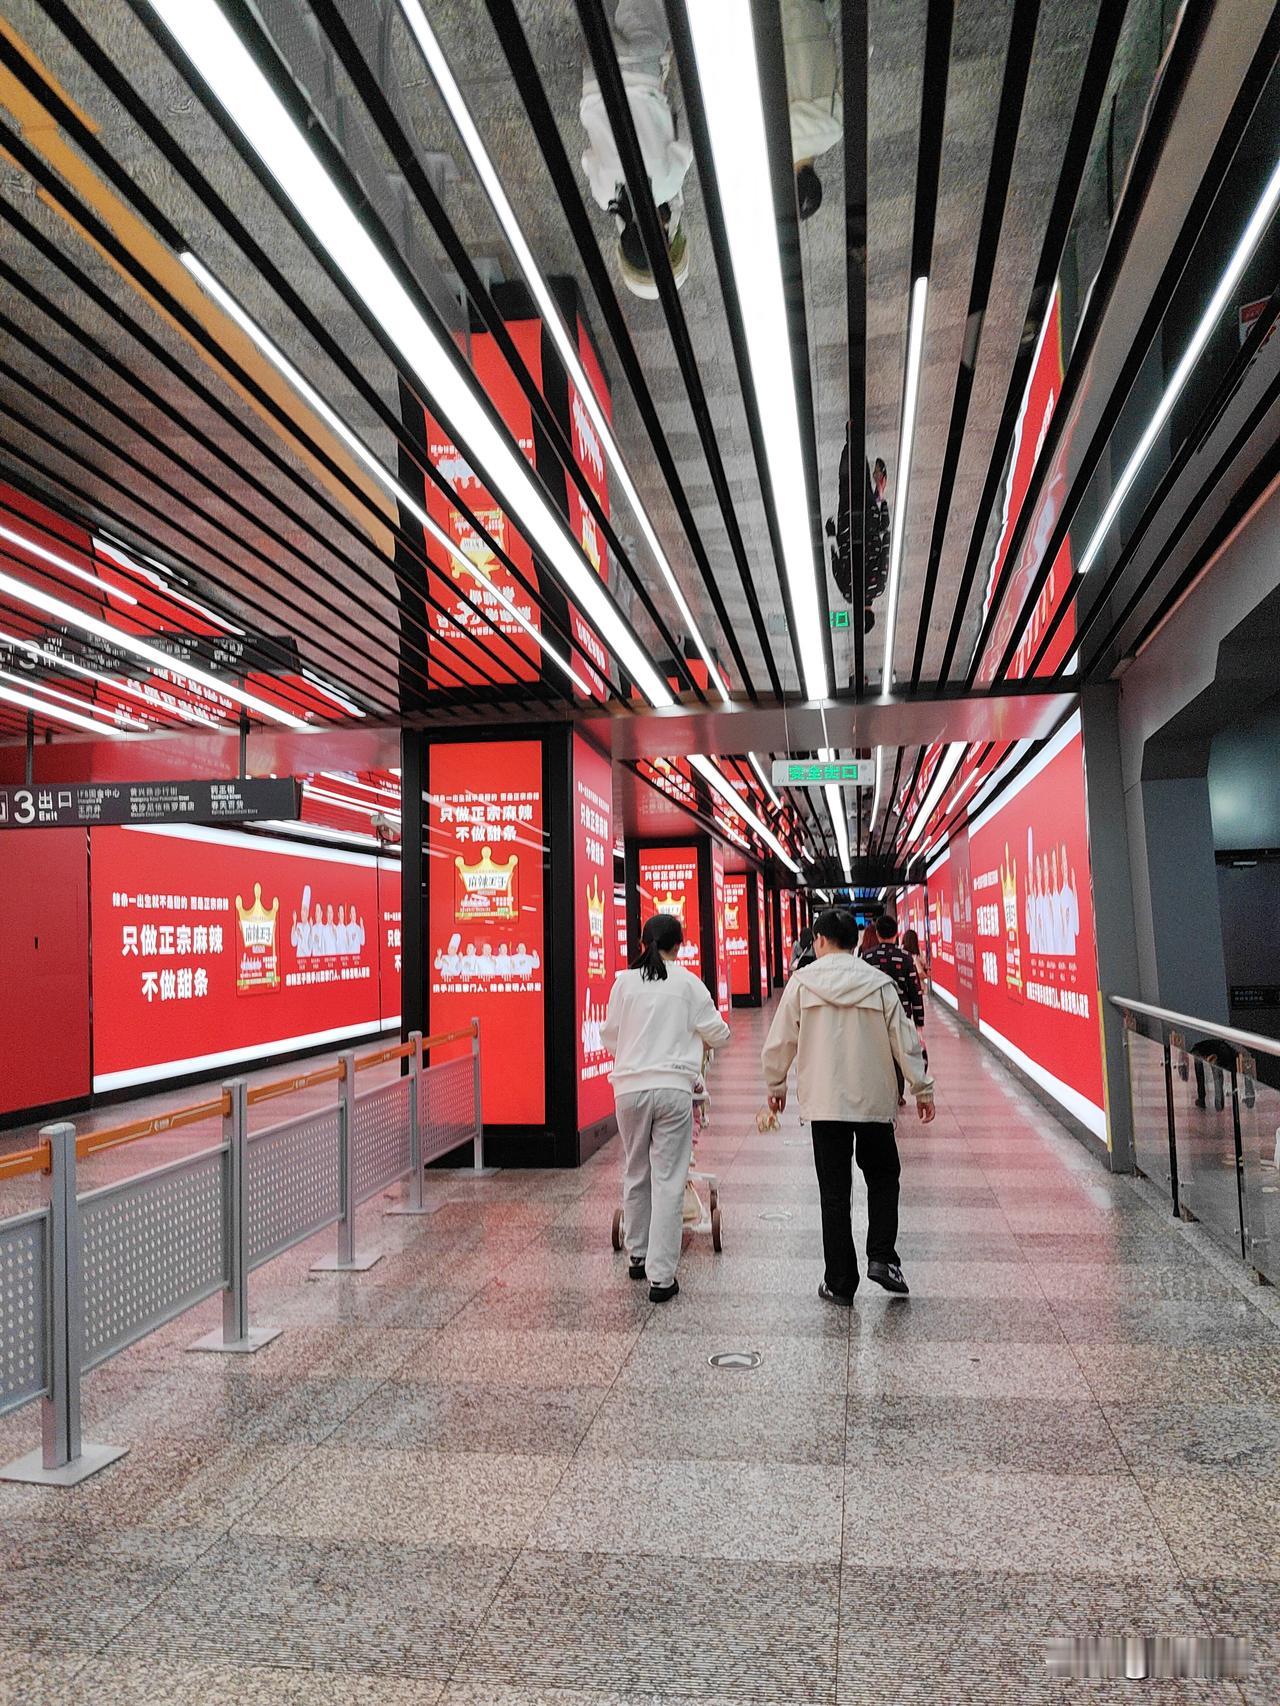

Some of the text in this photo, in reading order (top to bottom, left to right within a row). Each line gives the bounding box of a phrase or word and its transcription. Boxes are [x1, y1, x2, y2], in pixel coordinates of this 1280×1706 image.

[788, 764, 858, 781] 安全出口
[13, 789, 73, 824] 3 出口
[38, 809, 58, 822] Exit
[440, 804, 533, 823] 只做正宗麻辣
[455, 824, 517, 843] 不做甜条
[121, 924, 223, 956] 只做正宗麻辣
[141, 967, 209, 1003] 不做甜条
